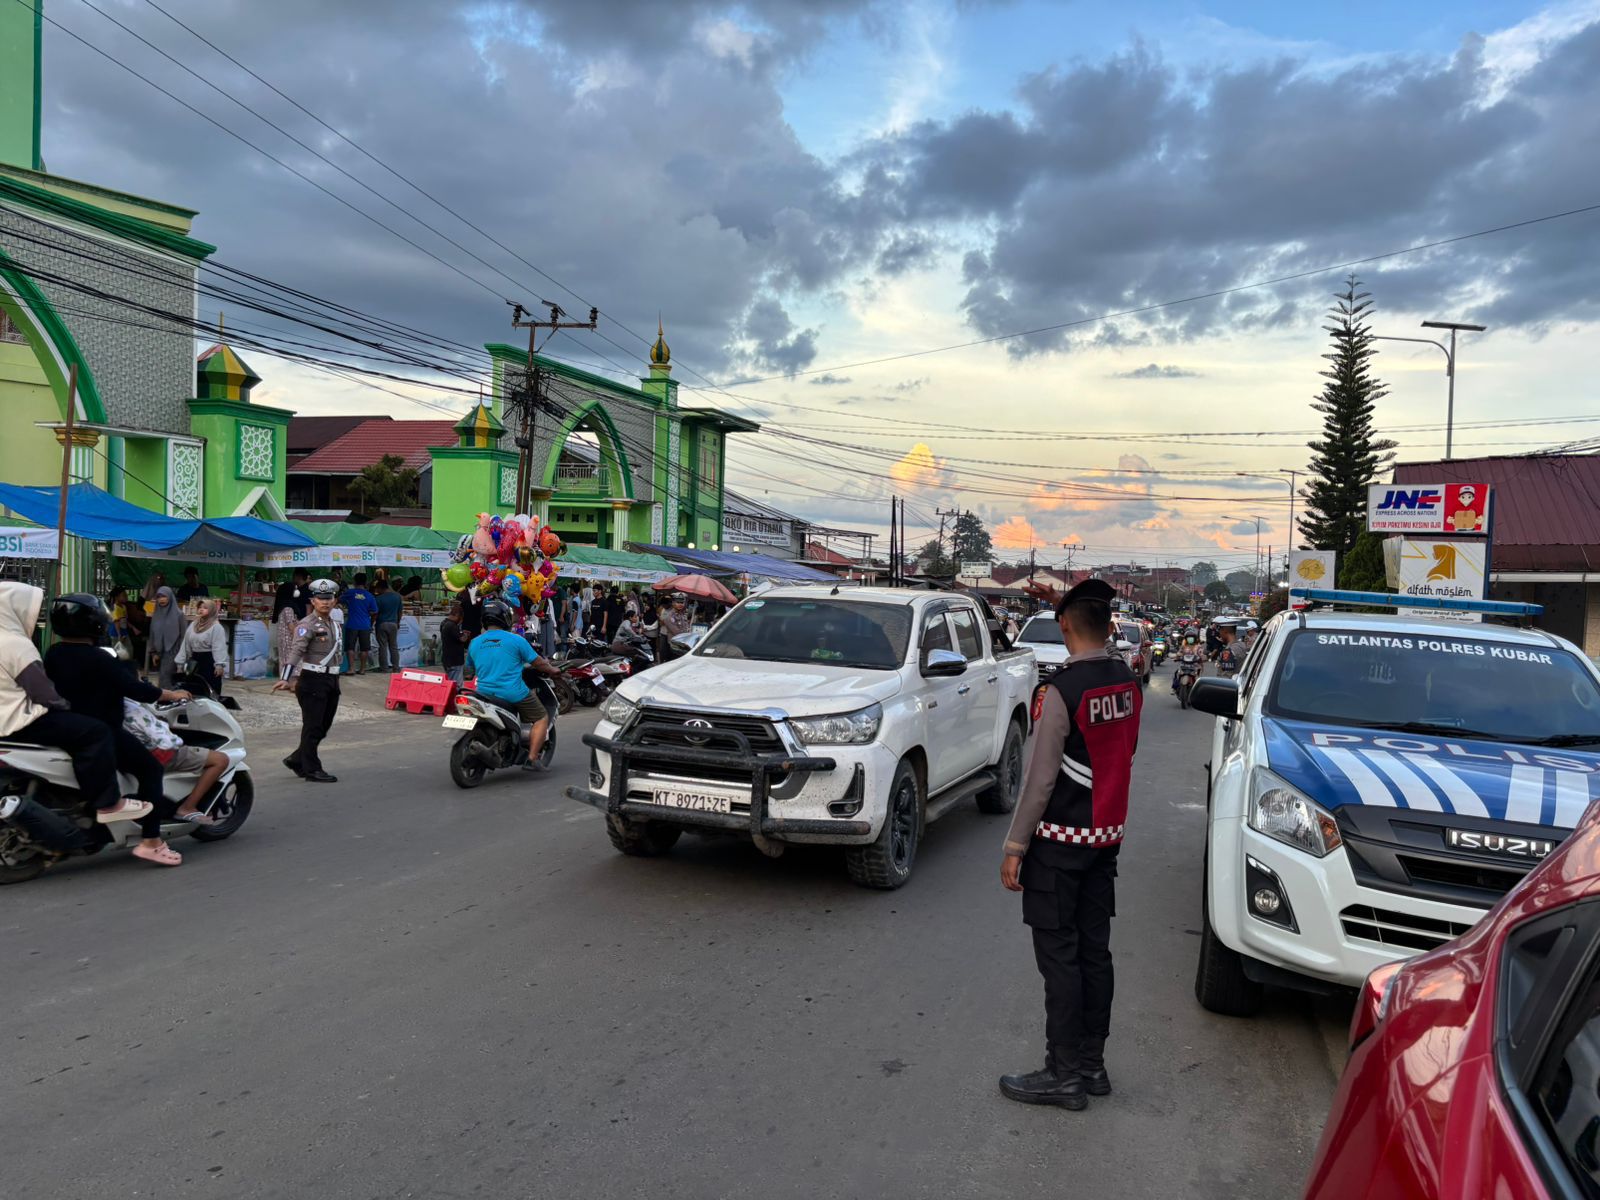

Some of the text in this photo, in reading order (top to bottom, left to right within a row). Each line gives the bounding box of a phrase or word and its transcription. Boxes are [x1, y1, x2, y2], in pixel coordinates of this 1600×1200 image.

[1377, 490, 1442, 509] JNE
[120, 540, 136, 551] BSI
[293, 551, 308, 561] BSI
[362, 551, 375, 561] BSI
[421, 553, 432, 562] BSI
[1407, 584, 1434, 596] alfath
[1318, 634, 1552, 665] SATLANTAS POLRES KUBAR
[1090, 690, 1133, 723] POLISI
[1312, 733, 1600, 773] POLIS
[655, 790, 670, 806] KT
[676, 793, 706, 810] 8971
[1451, 830, 1551, 857] ISUZU
